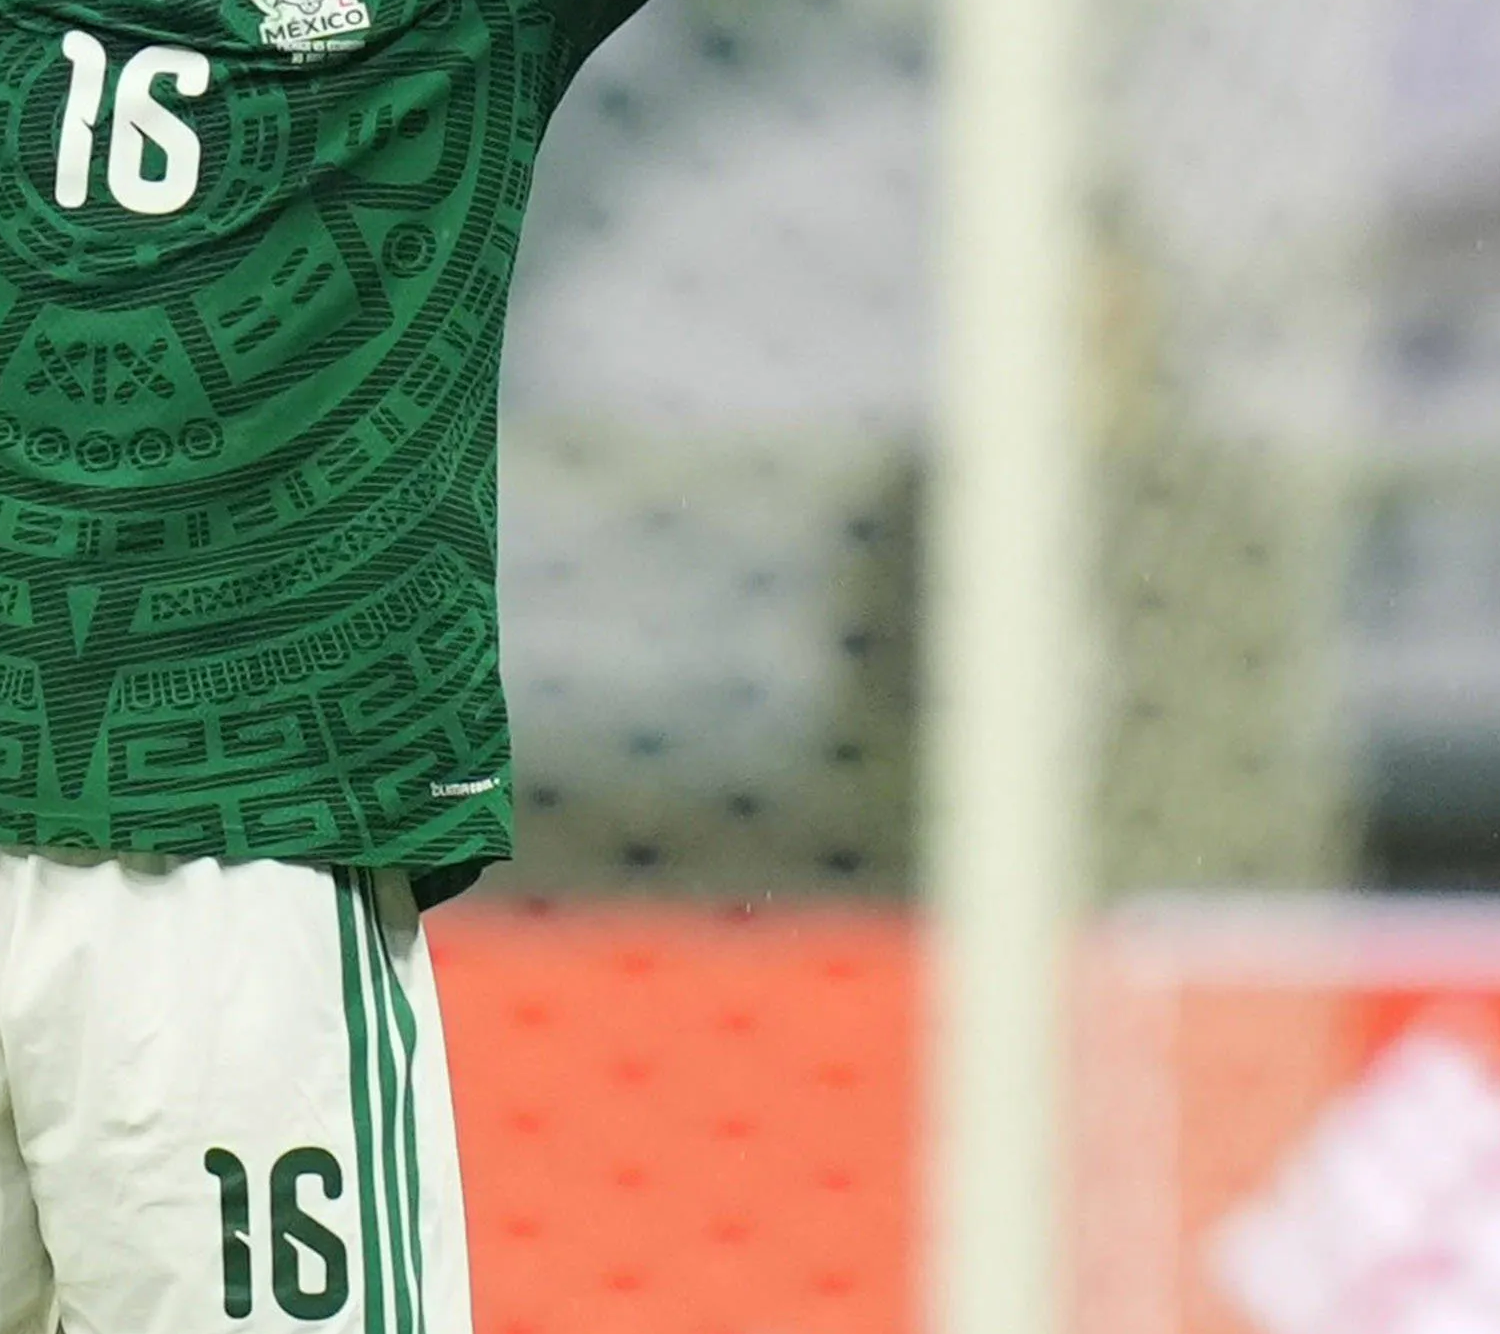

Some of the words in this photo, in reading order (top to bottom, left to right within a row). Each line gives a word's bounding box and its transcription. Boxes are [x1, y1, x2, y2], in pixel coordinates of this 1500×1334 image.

[264, 9, 364, 44] MÉXICO
[55, 29, 210, 215] 16
[204, 1146, 349, 1321] 16
